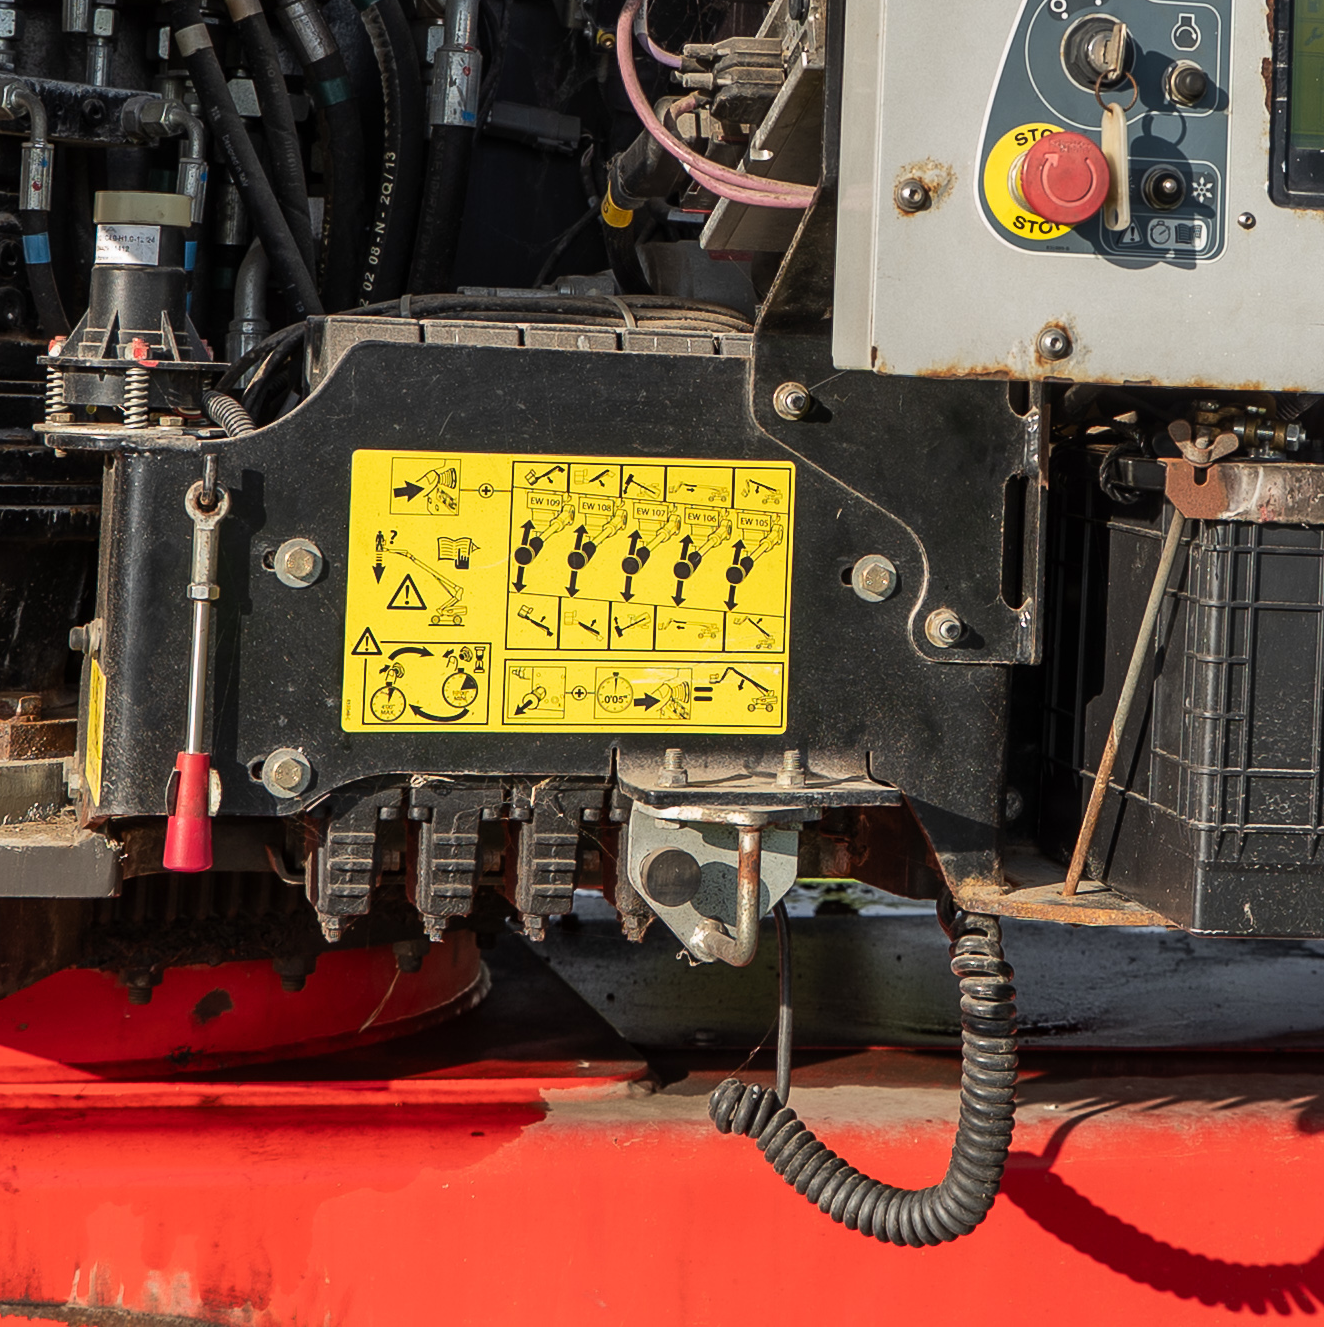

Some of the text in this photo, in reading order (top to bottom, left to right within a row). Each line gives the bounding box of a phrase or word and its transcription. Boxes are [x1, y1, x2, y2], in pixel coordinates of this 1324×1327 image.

[531, 497, 544, 505] EW
[652, 509, 665, 517] 107
[688, 513, 701, 521] EW
[755, 519, 768, 527] 105
